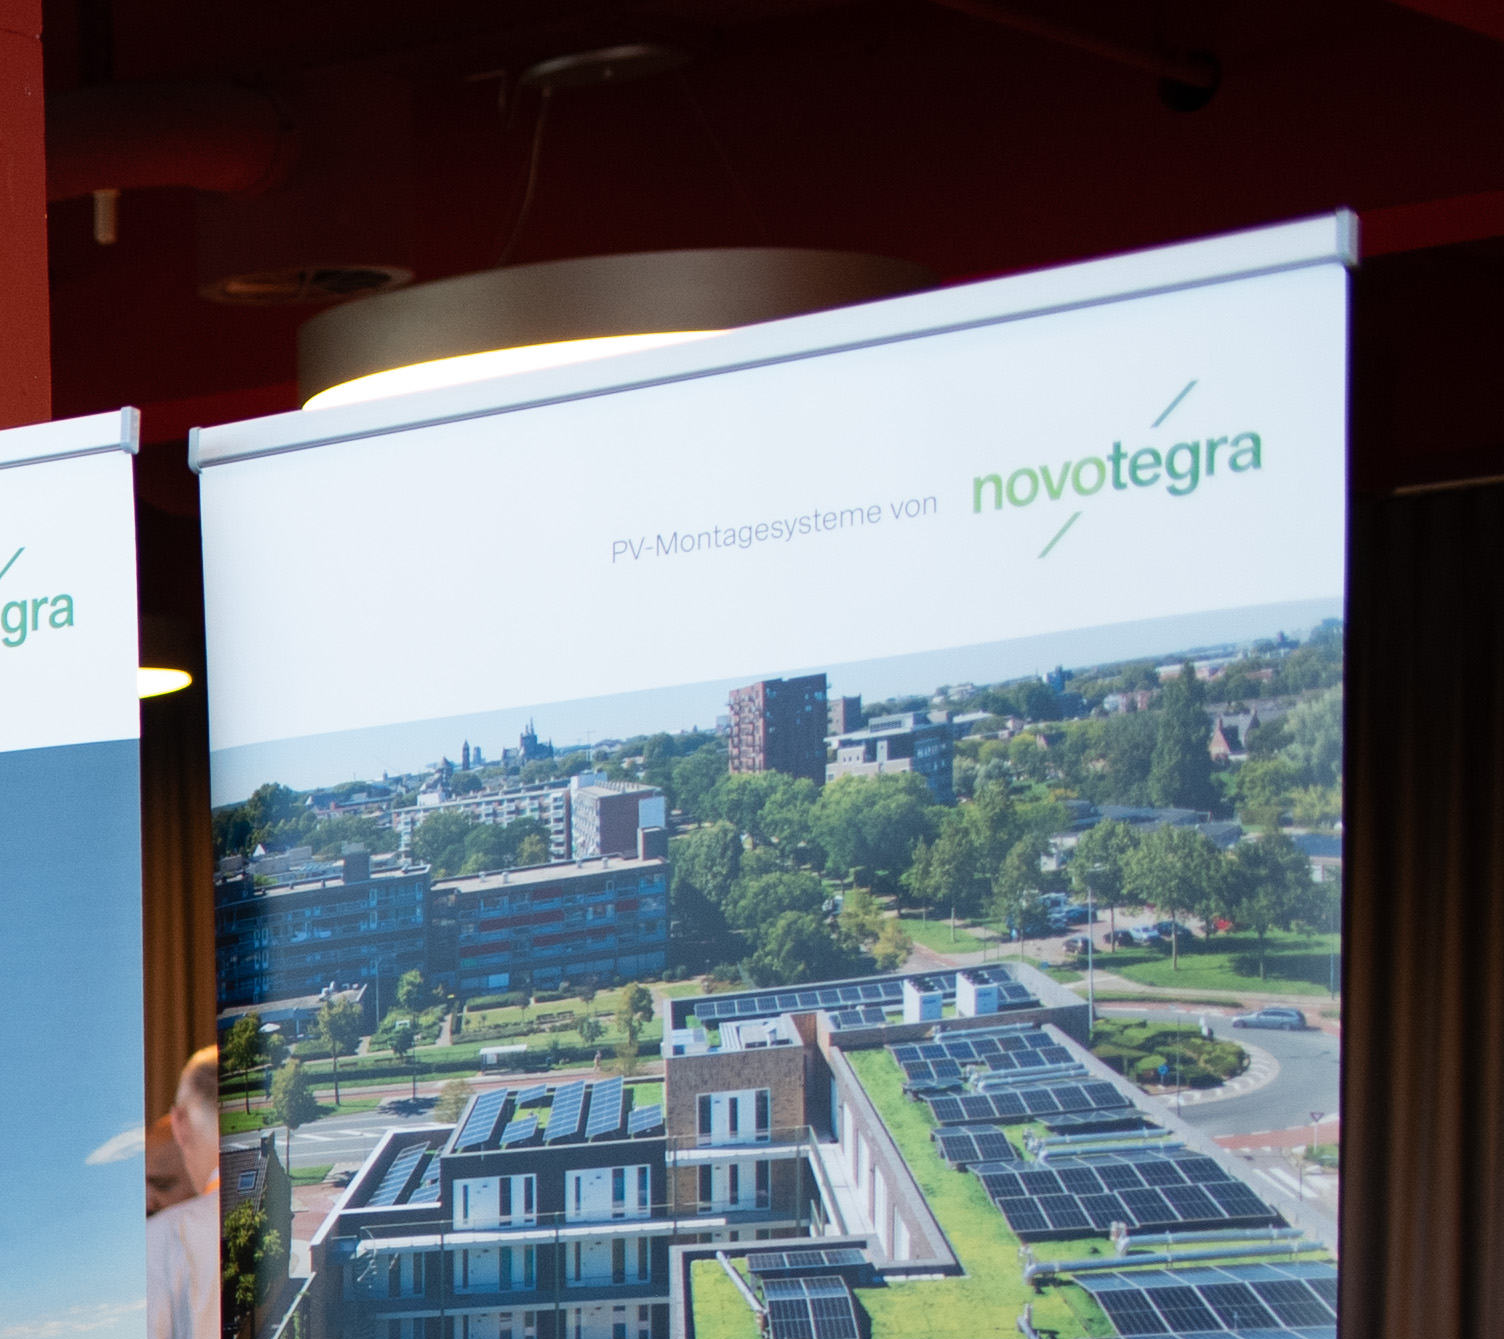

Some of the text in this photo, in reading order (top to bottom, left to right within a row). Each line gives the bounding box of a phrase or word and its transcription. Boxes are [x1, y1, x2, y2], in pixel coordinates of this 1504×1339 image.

[610, 430, 1262, 564] PV-Montagesysteme von novotegra
